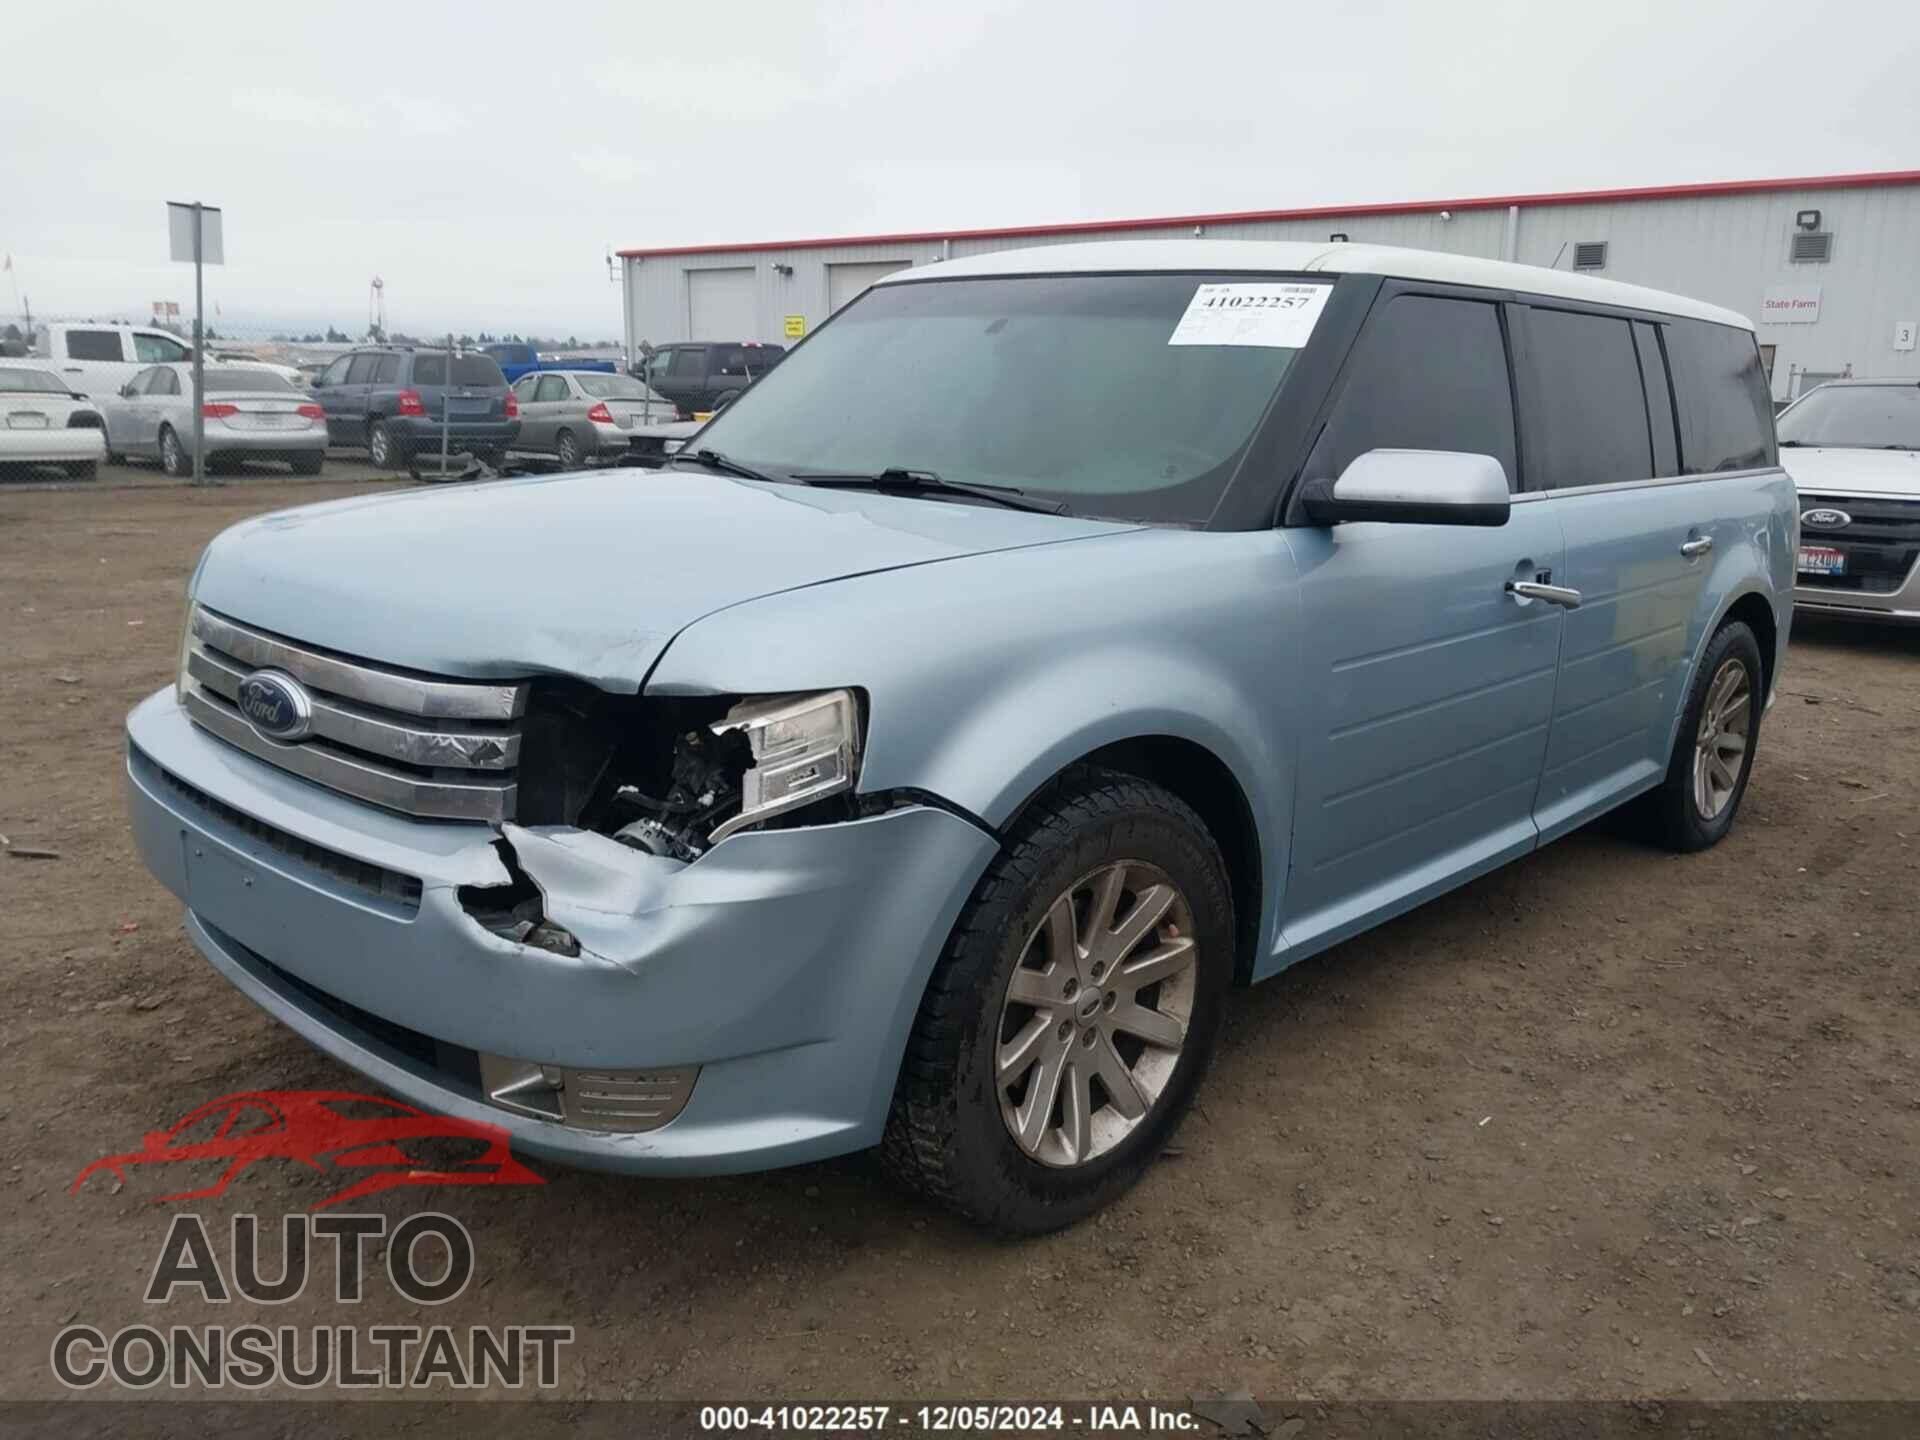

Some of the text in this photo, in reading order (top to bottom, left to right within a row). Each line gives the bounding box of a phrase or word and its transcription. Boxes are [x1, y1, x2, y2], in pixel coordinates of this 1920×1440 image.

[1202, 296, 1310, 309] 41022257
[1765, 299, 1817, 309] State Farm
[1900, 329, 1910, 342] 3
[1811, 512, 1837, 523] Ford
[244, 681, 283, 723] Ford
